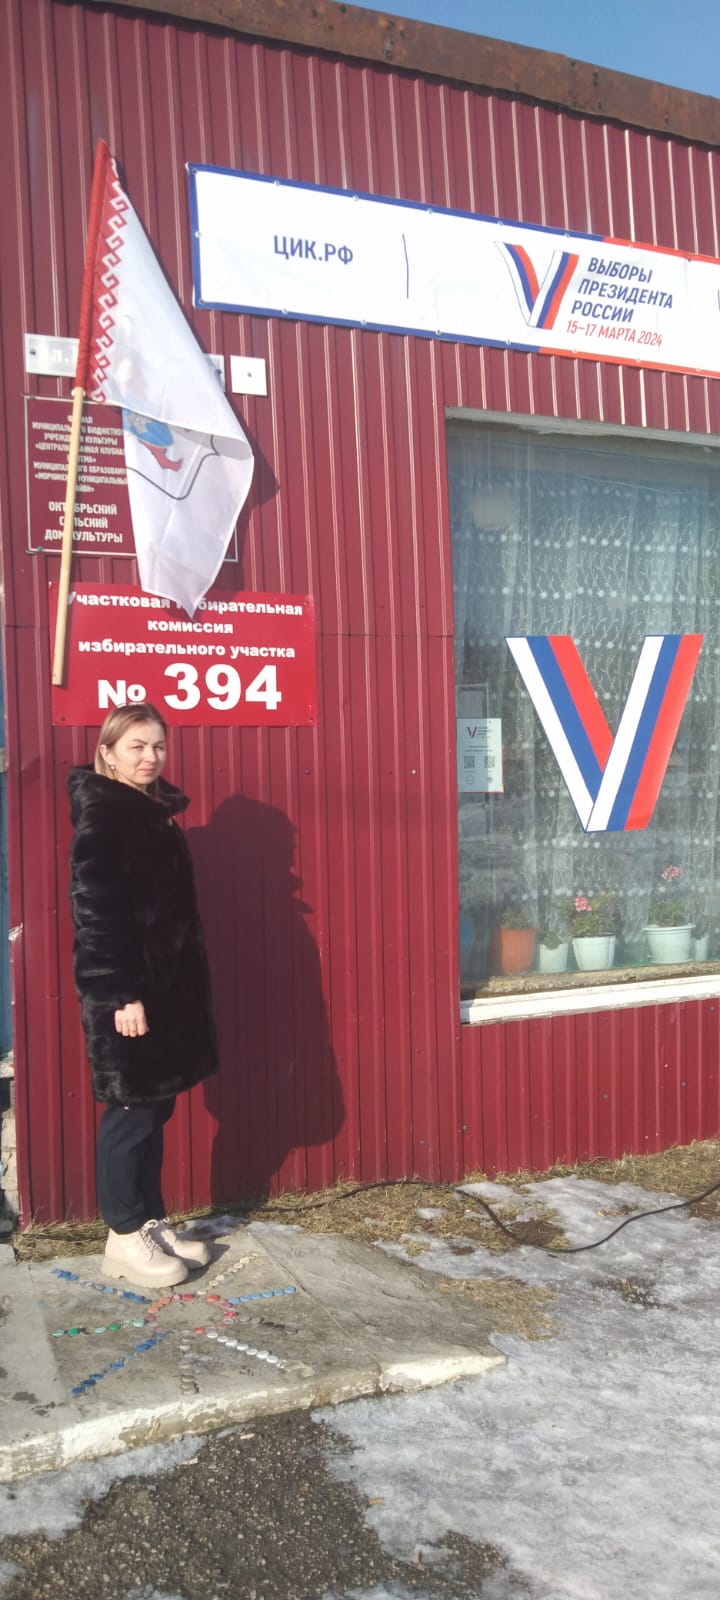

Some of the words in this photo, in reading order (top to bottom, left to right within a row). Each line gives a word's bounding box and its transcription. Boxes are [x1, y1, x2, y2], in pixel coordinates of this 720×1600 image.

[273, 234, 354, 265] ЦИК.РФ
[586, 257, 653, 284] ВЫБОРЫ
[577, 278, 674, 309] ПРЕЗИДЕНТА
[571, 299, 635, 323] РОССИИ
[597, 325, 636, 343] МАРТА
[637, 330, 663, 348] 2024
[48, 501, 118, 516] ОКТБРЬСКИЙ
[59, 515, 109, 529] СЛЬСКИЙ
[147, 620, 233, 634] комиссия
[78, 638, 225, 656] избирательного
[230, 644, 295, 660] участка
[163, 662, 283, 711] 394
